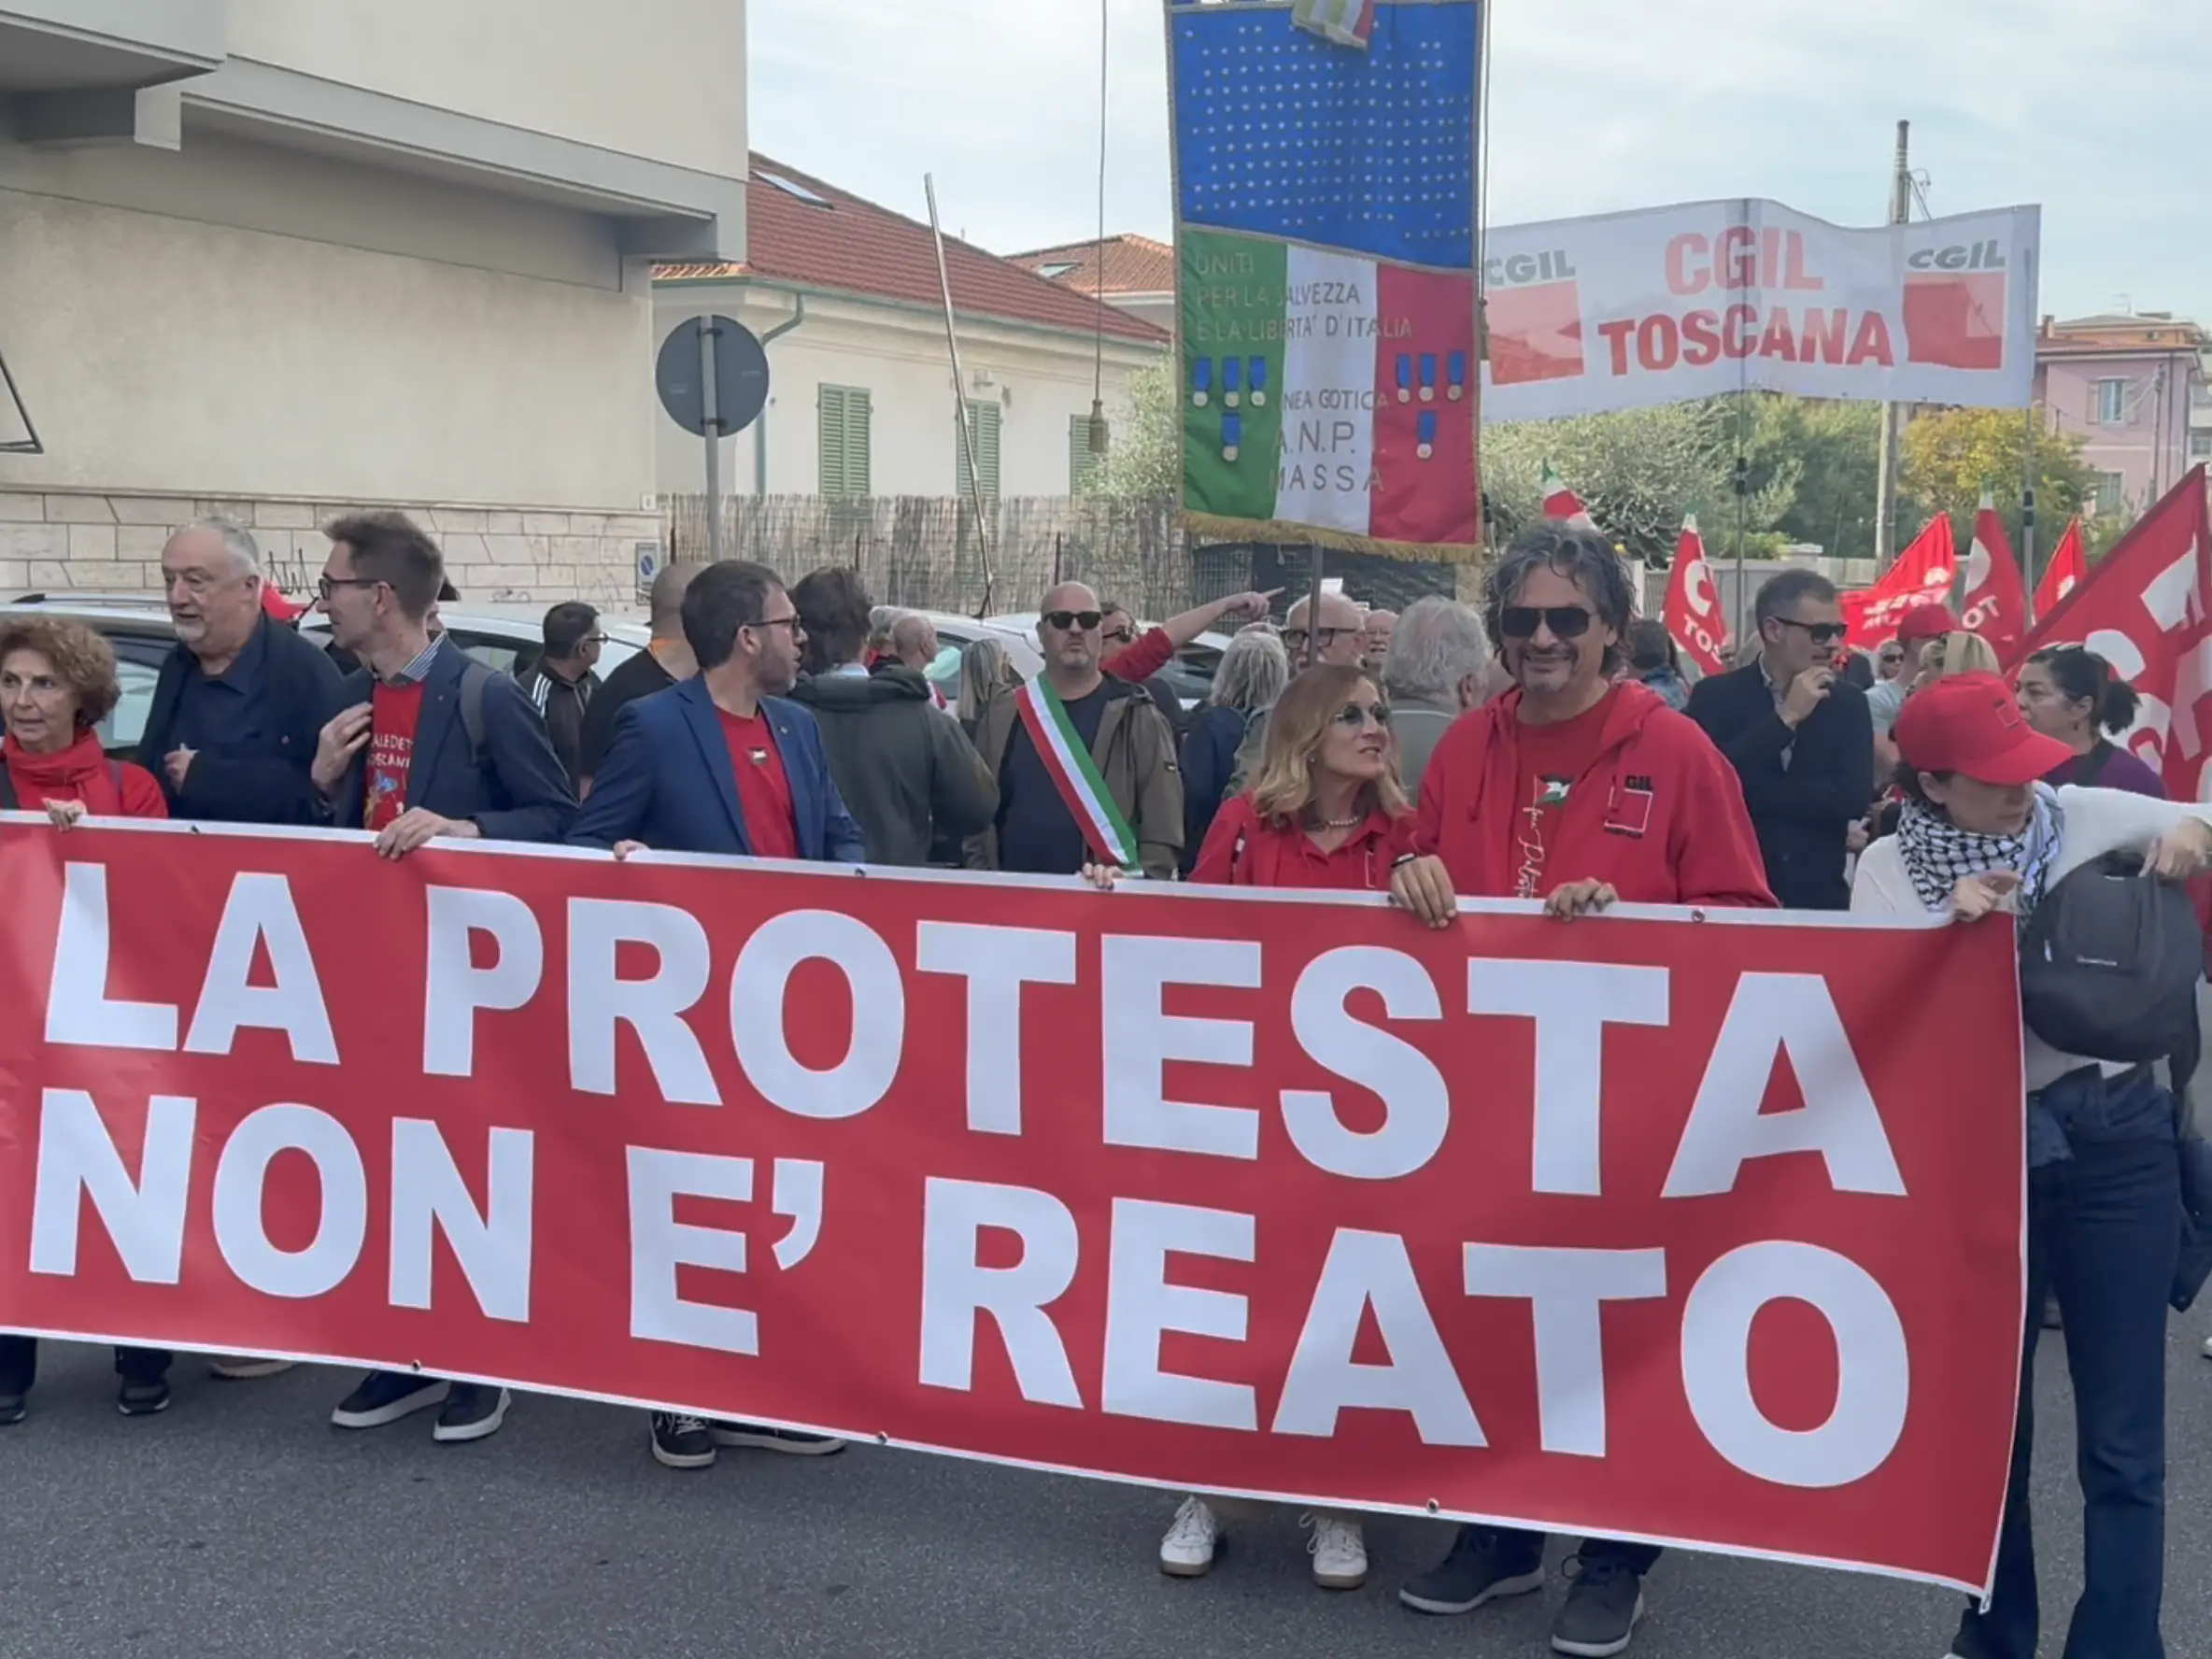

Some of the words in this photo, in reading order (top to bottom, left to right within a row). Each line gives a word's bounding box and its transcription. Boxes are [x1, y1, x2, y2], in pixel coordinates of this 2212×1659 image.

[1196, 251, 1254, 275] UNITI
[1485, 249, 1576, 285] CGIL
[1665, 226, 1824, 296] CGIL
[1907, 239, 2006, 269] CGIL
[1197, 286, 1237, 308] PER
[1244, 284, 1269, 307] LA
[1276, 281, 1360, 307] SALVEZZA
[1197, 319, 1209, 342] E
[1214, 319, 1242, 341] LA
[1597, 303, 1894, 376] TOSCANA
[1318, 389, 1388, 412] GOTICA
[44, 861, 340, 1065] LA
[423, 885, 1907, 1198] PROTESTA
[29, 1087, 534, 1323] NON
[626, 1145, 824, 1355] E'
[919, 1176, 1909, 1487] REATO
